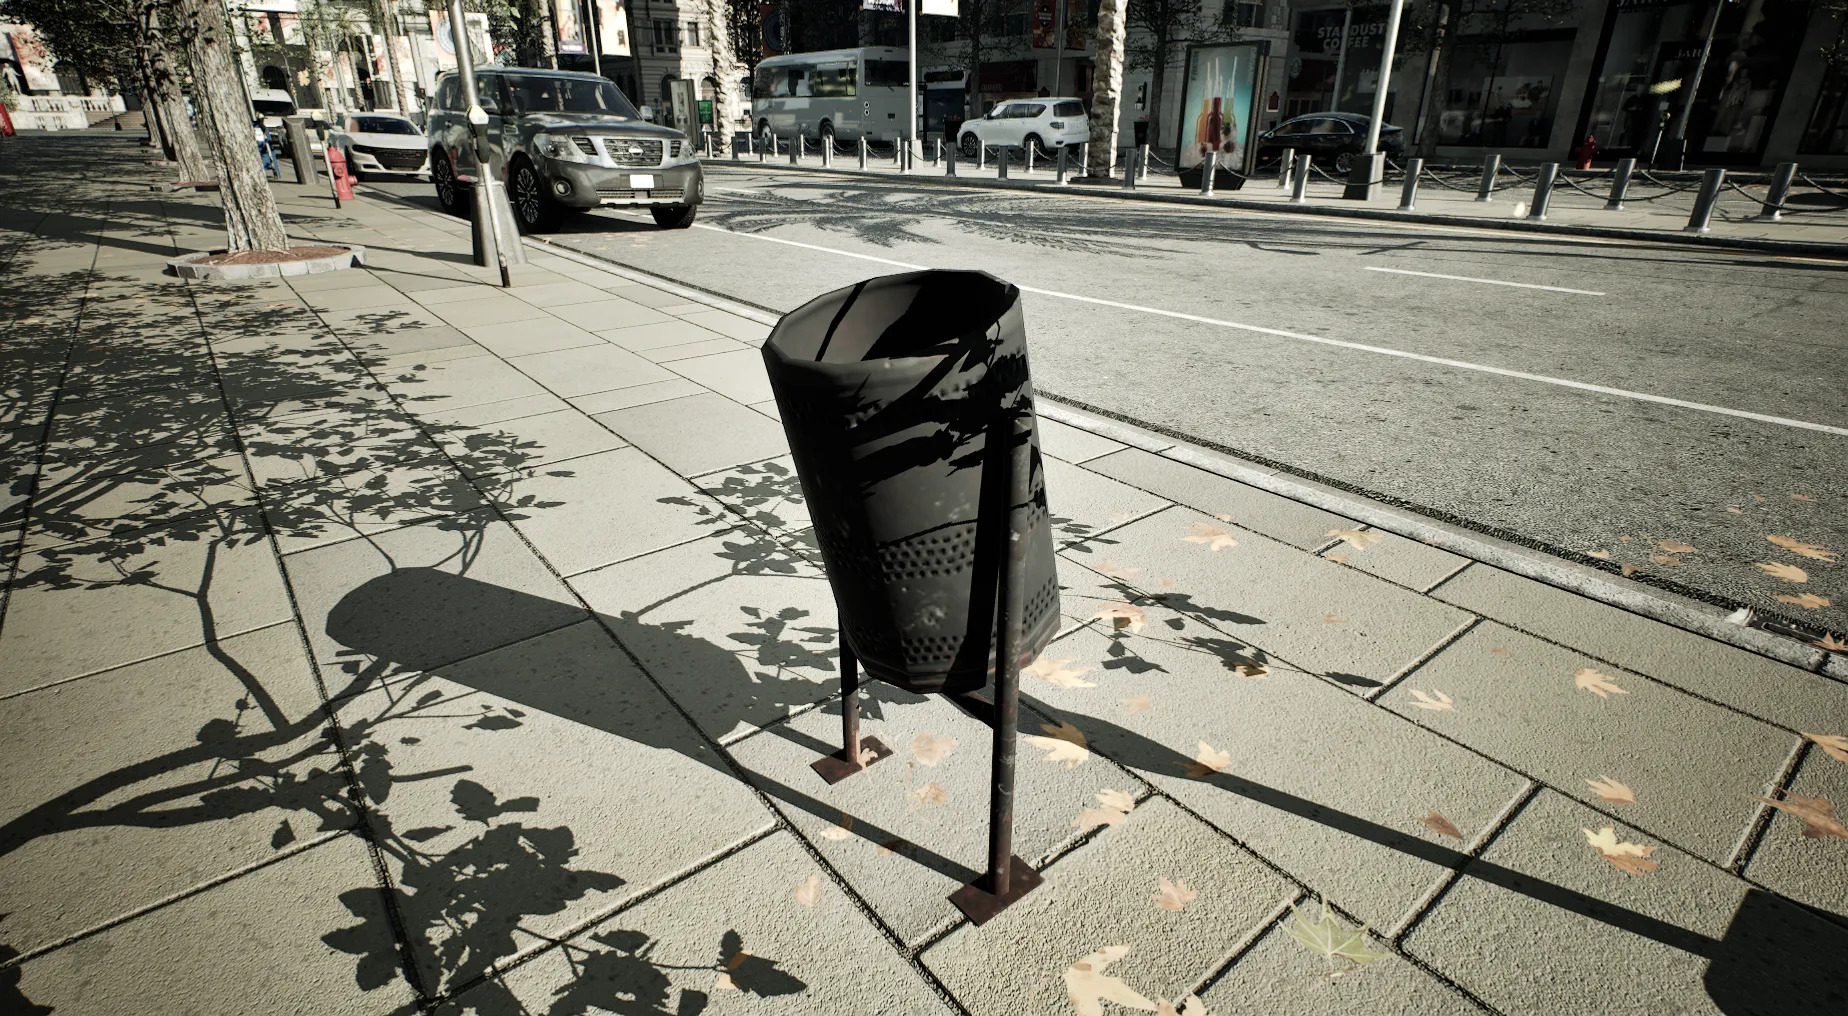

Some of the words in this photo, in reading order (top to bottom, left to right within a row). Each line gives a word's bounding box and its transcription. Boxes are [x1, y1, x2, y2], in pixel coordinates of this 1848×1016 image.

[1317, 24, 1386, 38] STADUST
[1323, 36, 1370, 49] COFEE
[1674, 48, 1706, 58] JAR
